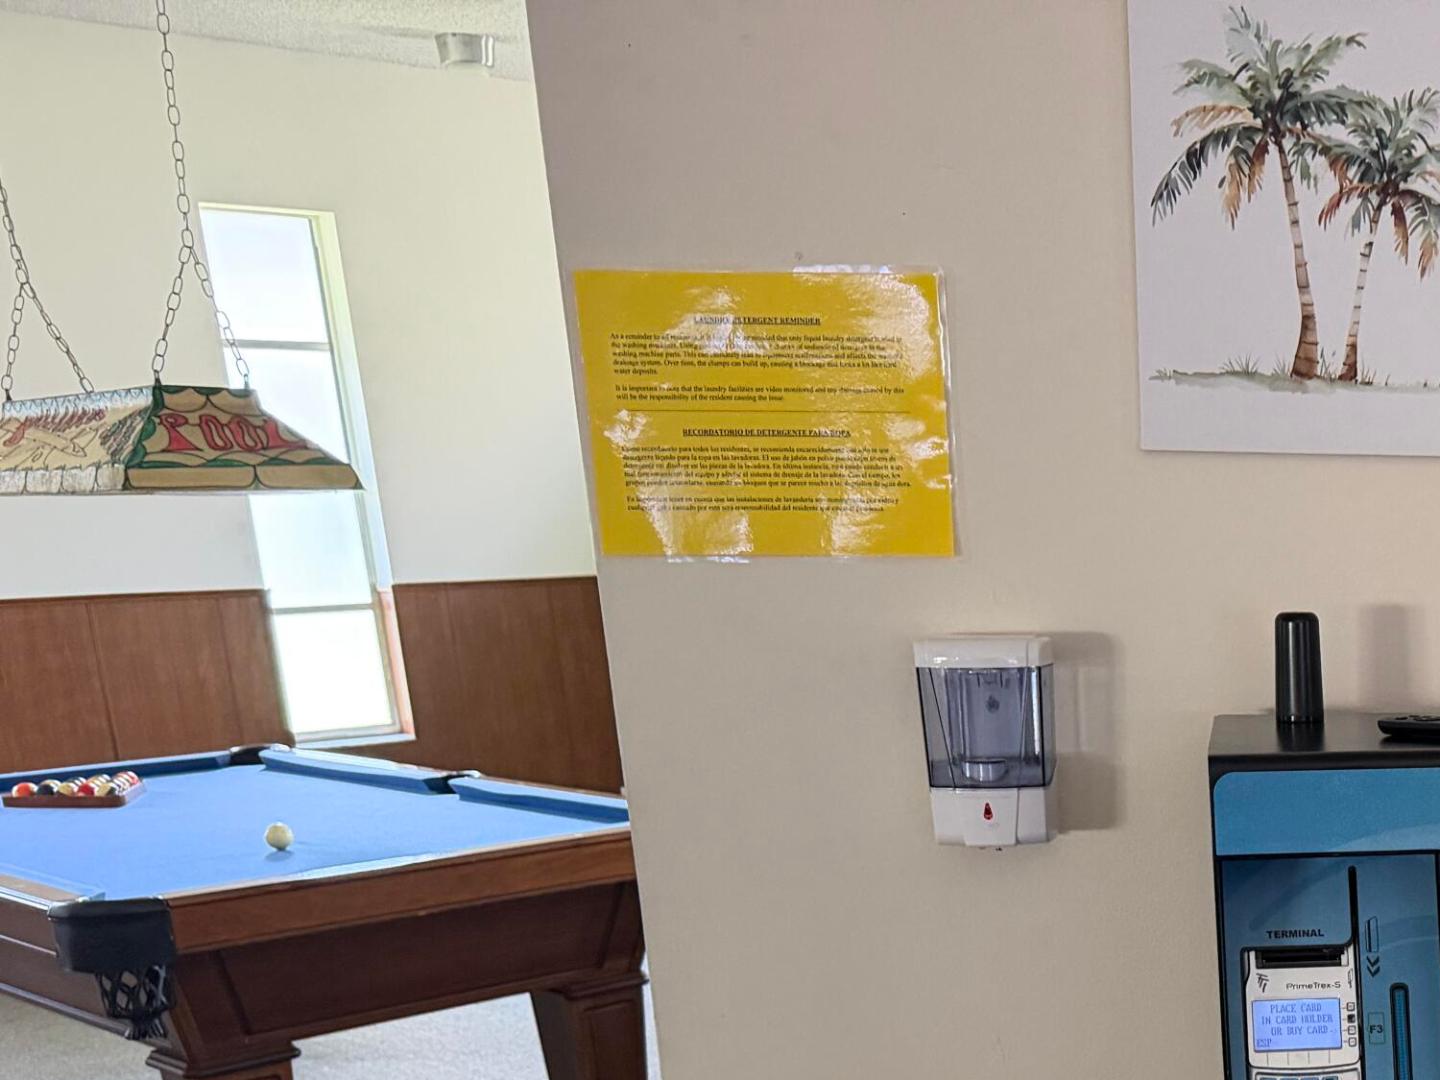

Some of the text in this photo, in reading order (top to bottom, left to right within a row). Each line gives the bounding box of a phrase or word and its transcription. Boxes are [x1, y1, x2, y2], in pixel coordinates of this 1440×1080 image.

[780, 317, 821, 326] REMINDER
[158, 414, 309, 451] POOL
[683, 429, 745, 437] RECORDATORIO
[1266, 929, 1325, 939] TERMINAL
[1286, 981, 1341, 990] PrimeTrex-S
[1270, 1002, 1322, 1014] PLACE CARD
[1261, 1014, 1334, 1025] IN CARD HOLDER
[1271, 1025, 1328, 1036] OR BUY CARD
[1369, 1024, 1383, 1034] F3
